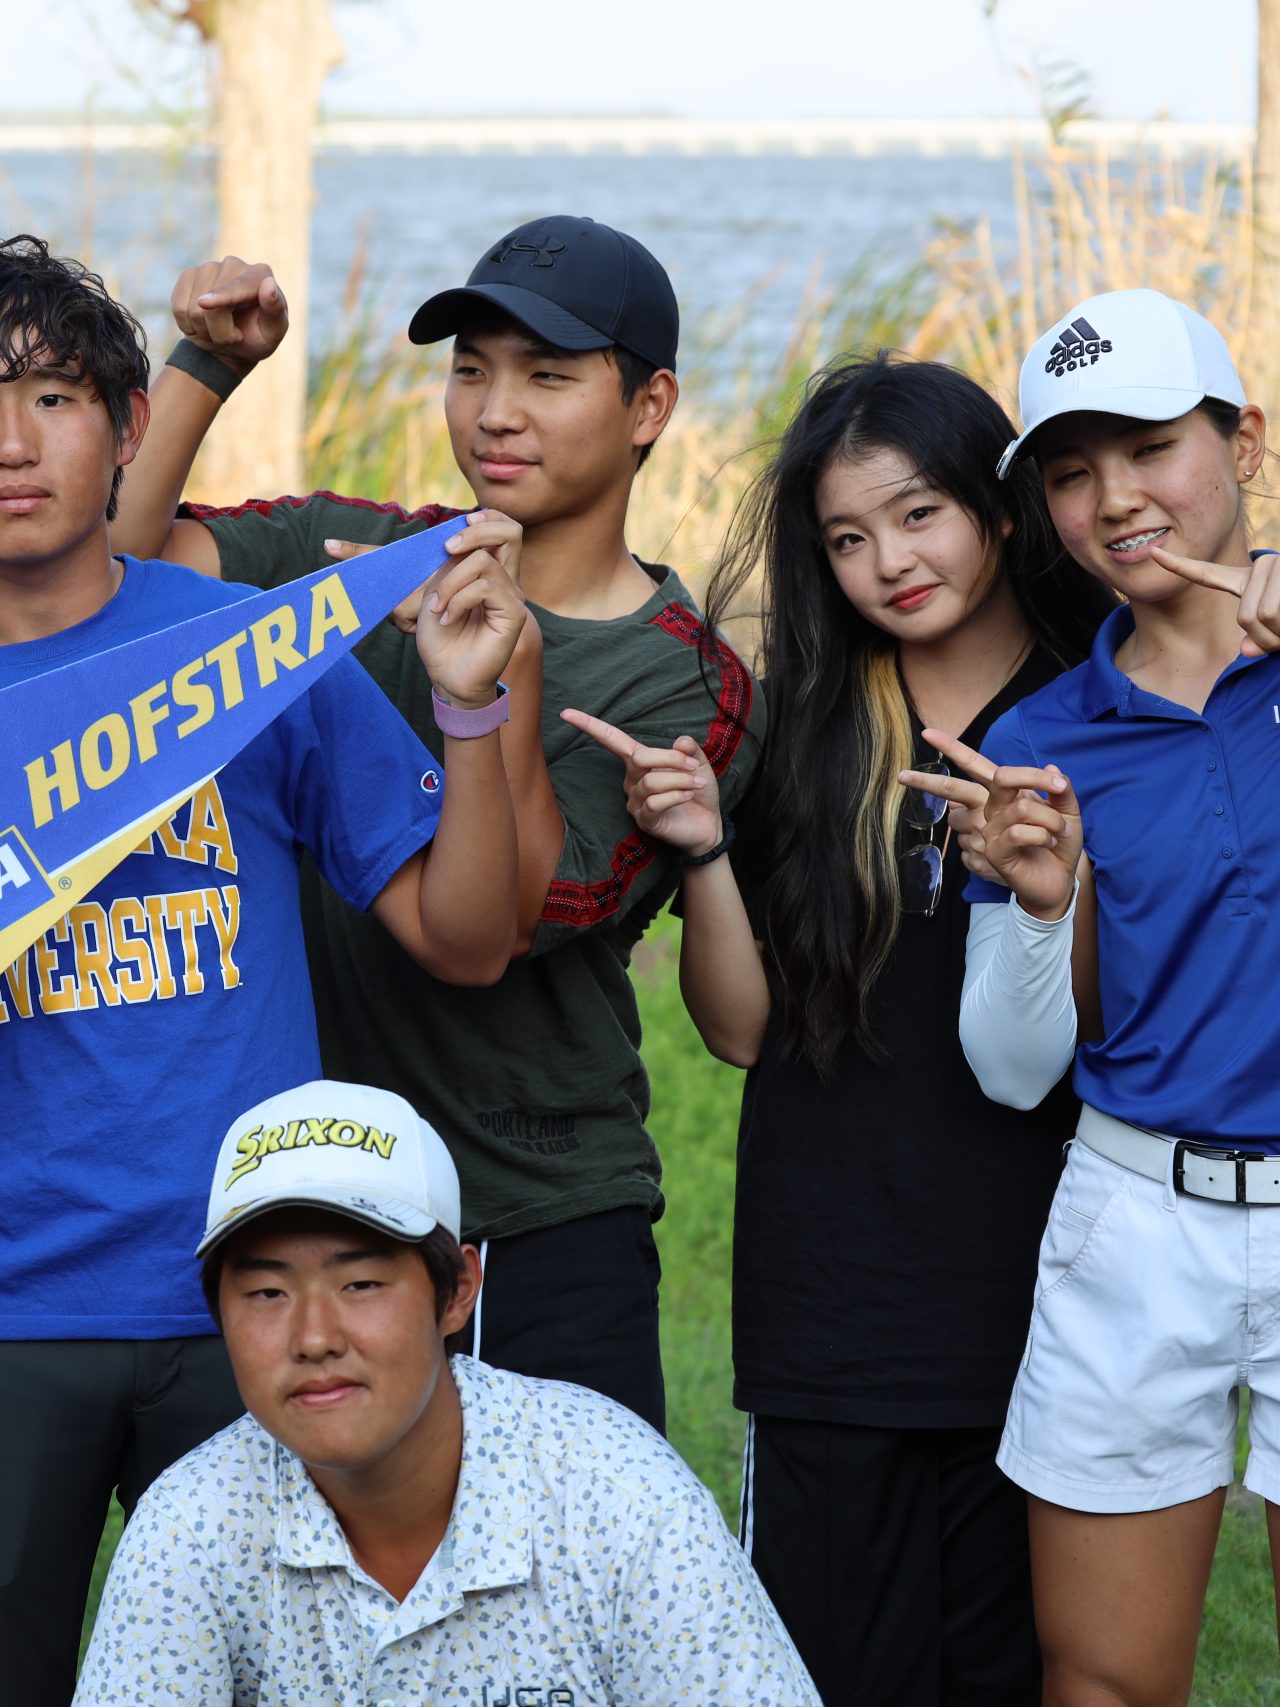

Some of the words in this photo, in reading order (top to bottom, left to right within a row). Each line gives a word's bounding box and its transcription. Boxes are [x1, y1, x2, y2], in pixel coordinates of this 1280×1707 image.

[1045, 339, 1113, 373] adidas
[1054, 354, 1100, 377] GOLF
[23, 572, 361, 829] HOFSTRA
[478, 1109, 575, 1140] PORTLAND
[224, 1118, 397, 1192] SRIXON
